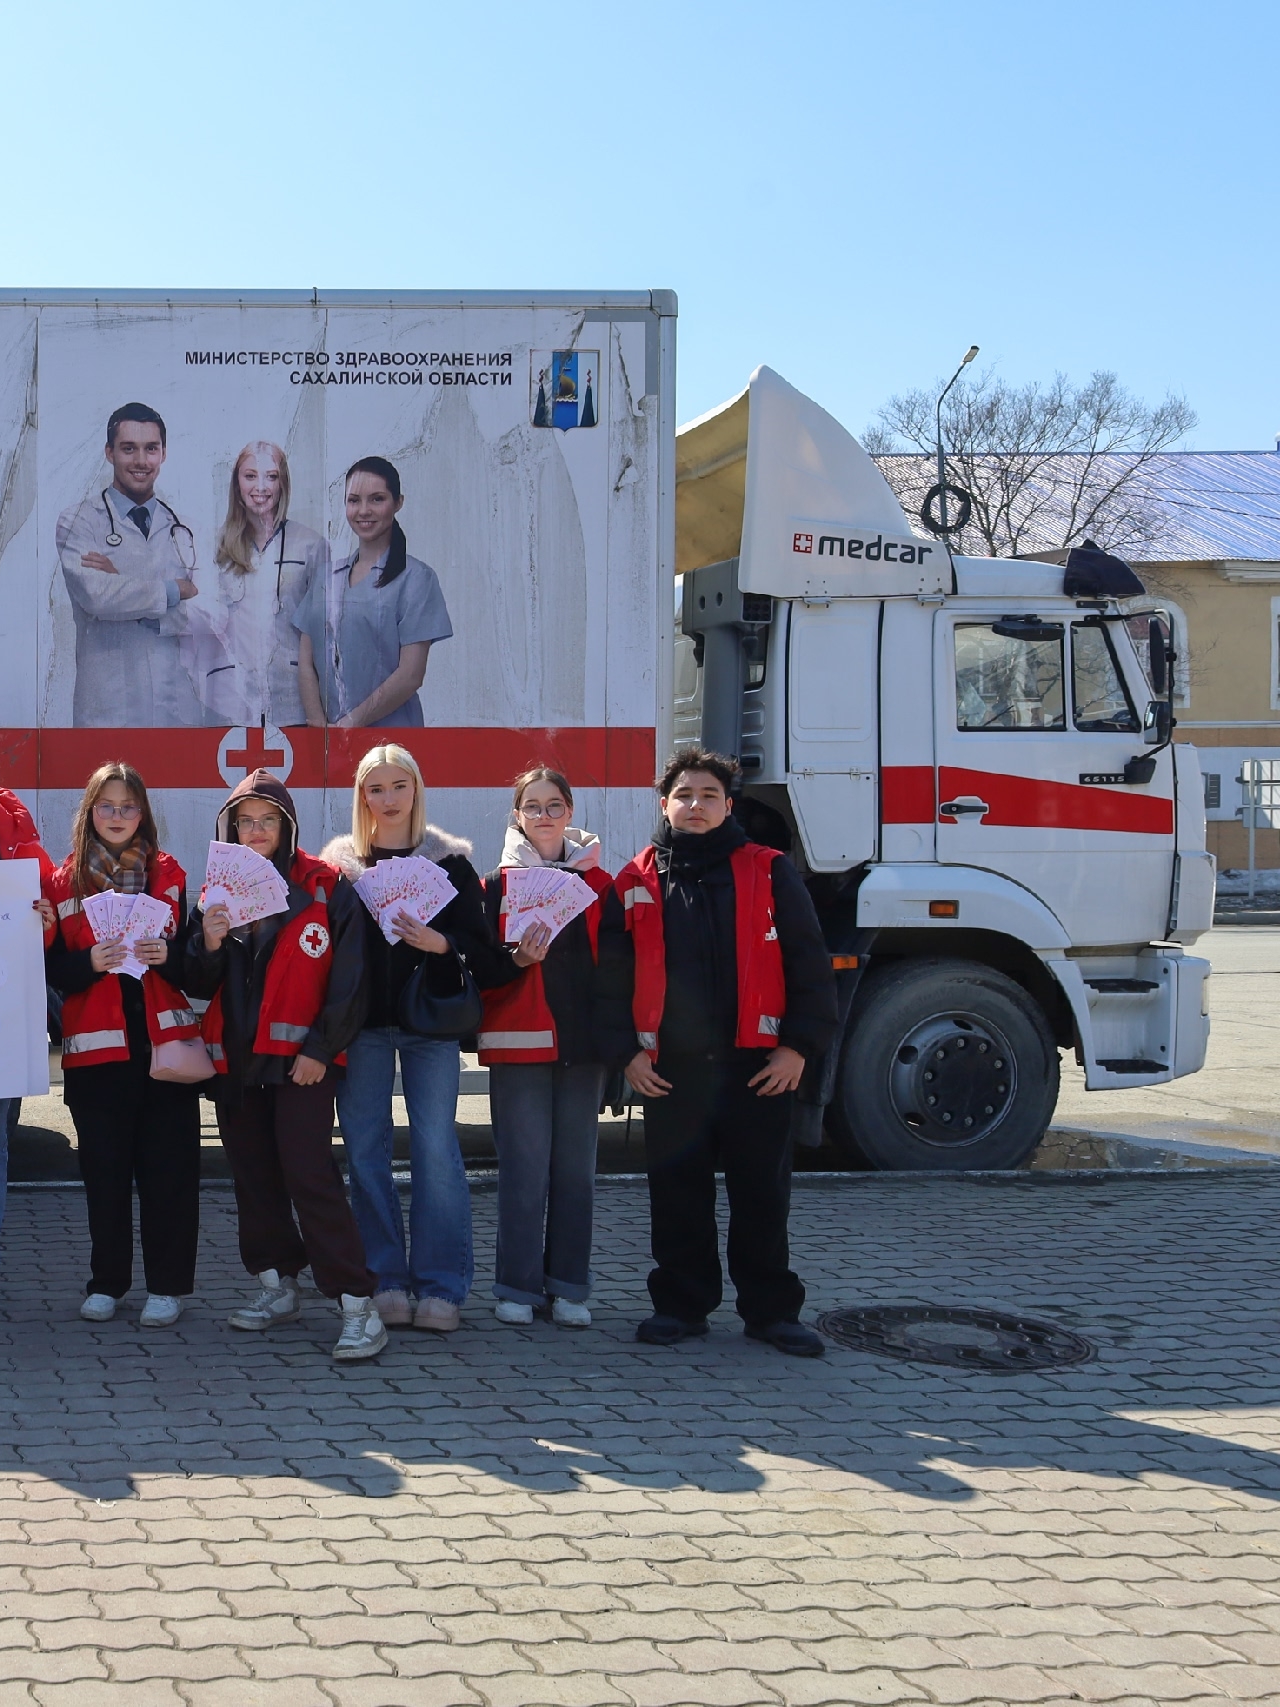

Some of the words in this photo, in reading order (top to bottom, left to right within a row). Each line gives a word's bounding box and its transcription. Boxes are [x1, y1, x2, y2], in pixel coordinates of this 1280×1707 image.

[185, 351, 330, 365] МИНИСТЕРСТВО
[335, 351, 512, 368] ЗДРАВООХРАНЕНИЯ
[289, 369, 423, 385] САХАЛИНСКОЙ
[428, 372, 512, 386] ОБЛАСТИ
[818, 535, 933, 565] medcar
